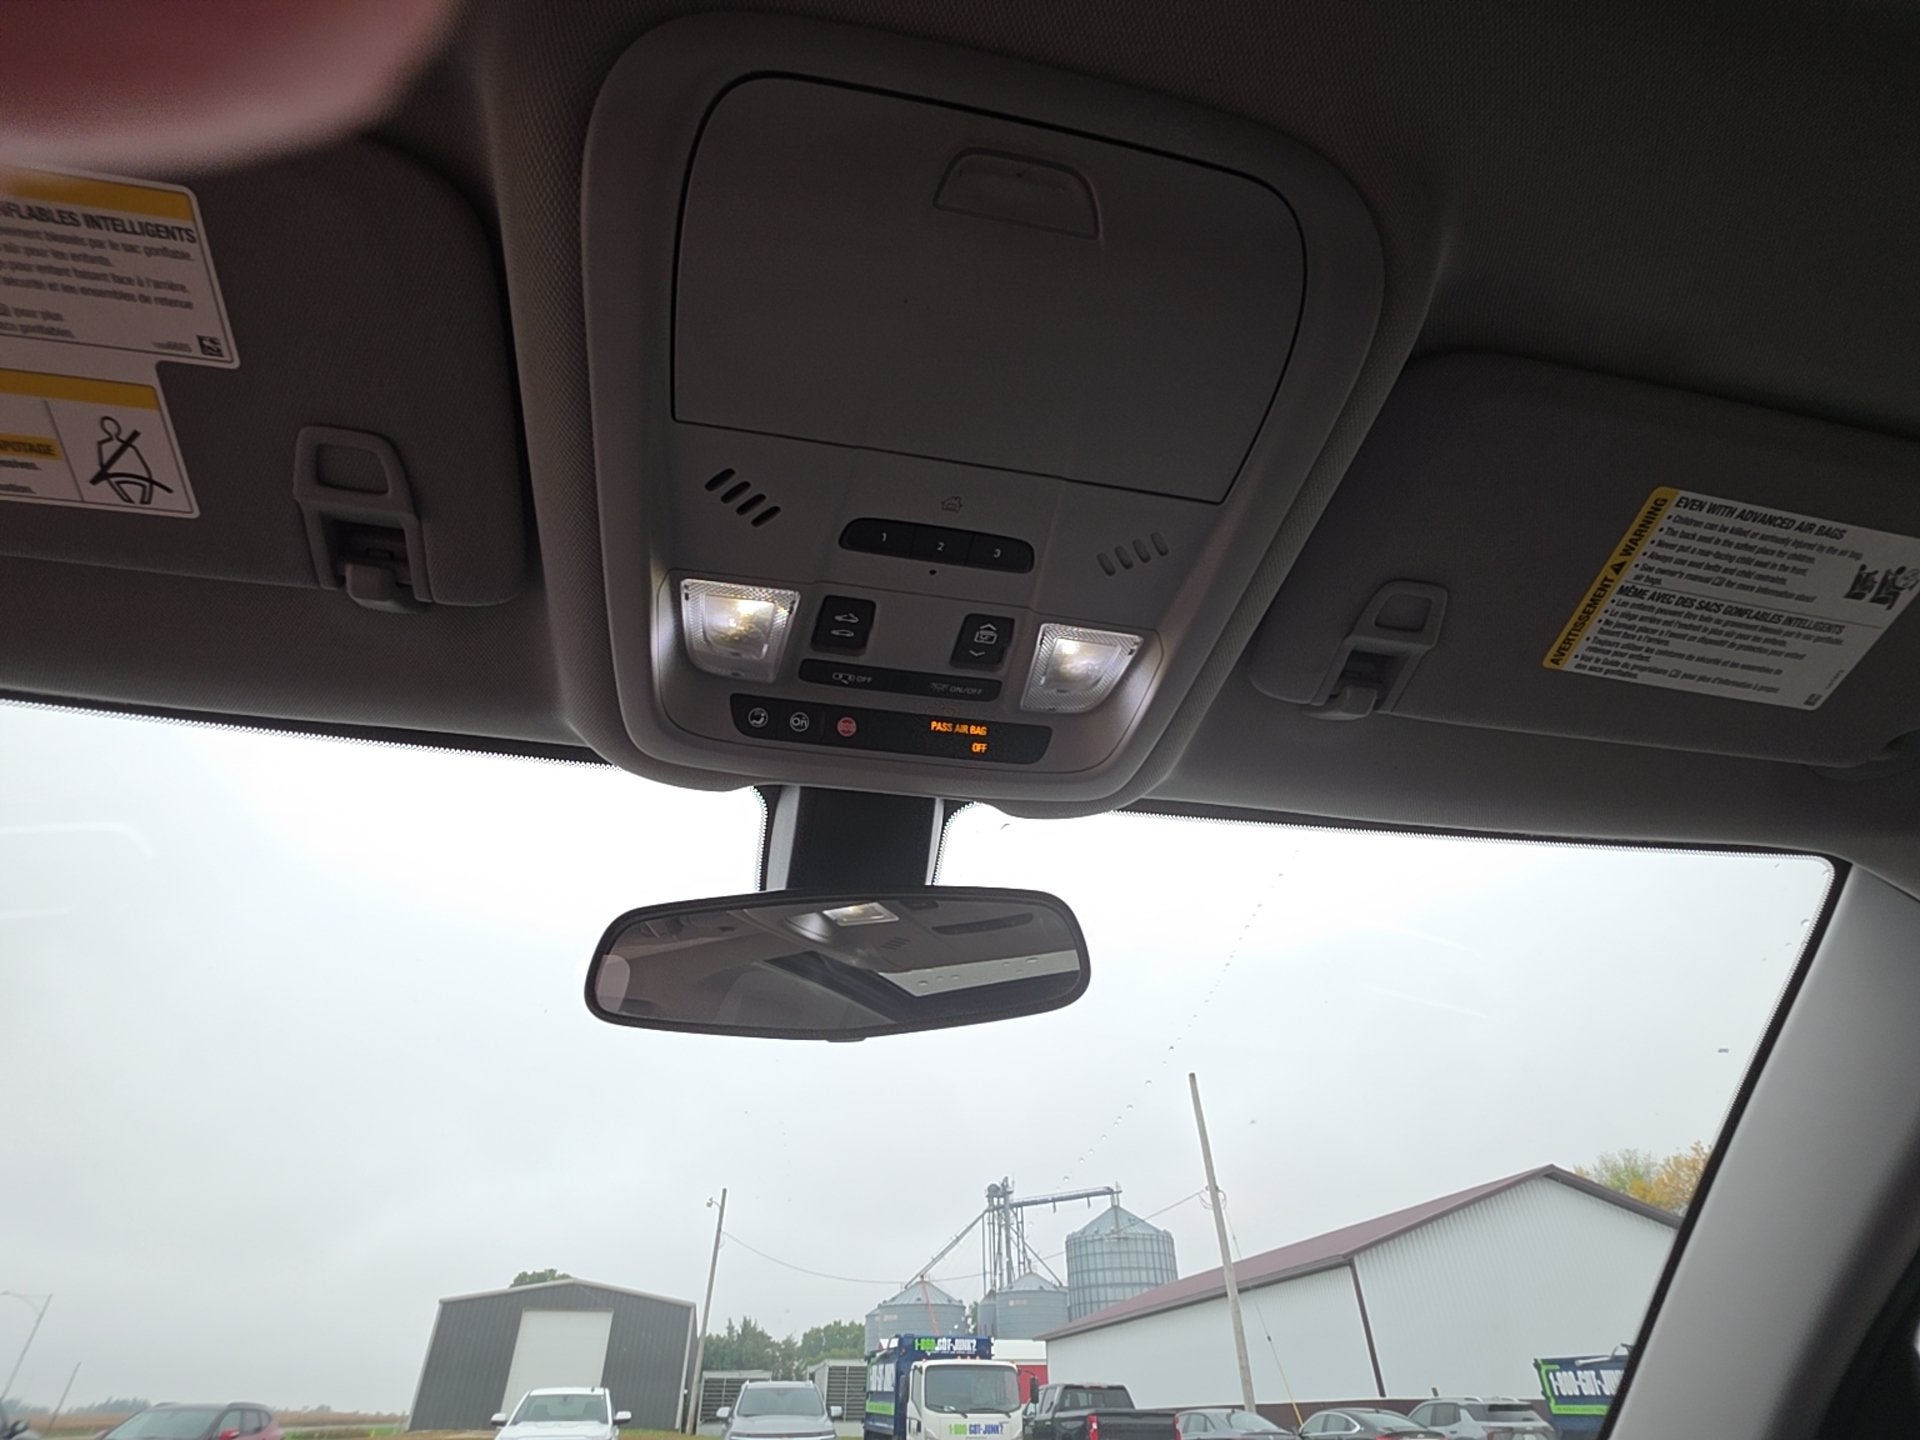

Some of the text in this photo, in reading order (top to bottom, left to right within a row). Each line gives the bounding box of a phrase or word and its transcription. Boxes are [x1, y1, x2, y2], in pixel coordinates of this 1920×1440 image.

[82, 213, 196, 243] INTELLIGENTS
[1675, 496, 1847, 540] EVEN WITH ADVANCED AIR BAGS
[881, 532, 1001, 559] 1 2 3
[1550, 497, 1668, 665] AVERTISSEMENT WARNING
[1616, 585, 1846, 635] MÊME AVEC DES SACS GONFLABLES INTELLIGENTS
[856, 675, 983, 697] OFF ON/OFF
[931, 721, 988, 736] PASS AIR BAG
[972, 743, 988, 753] OFF
